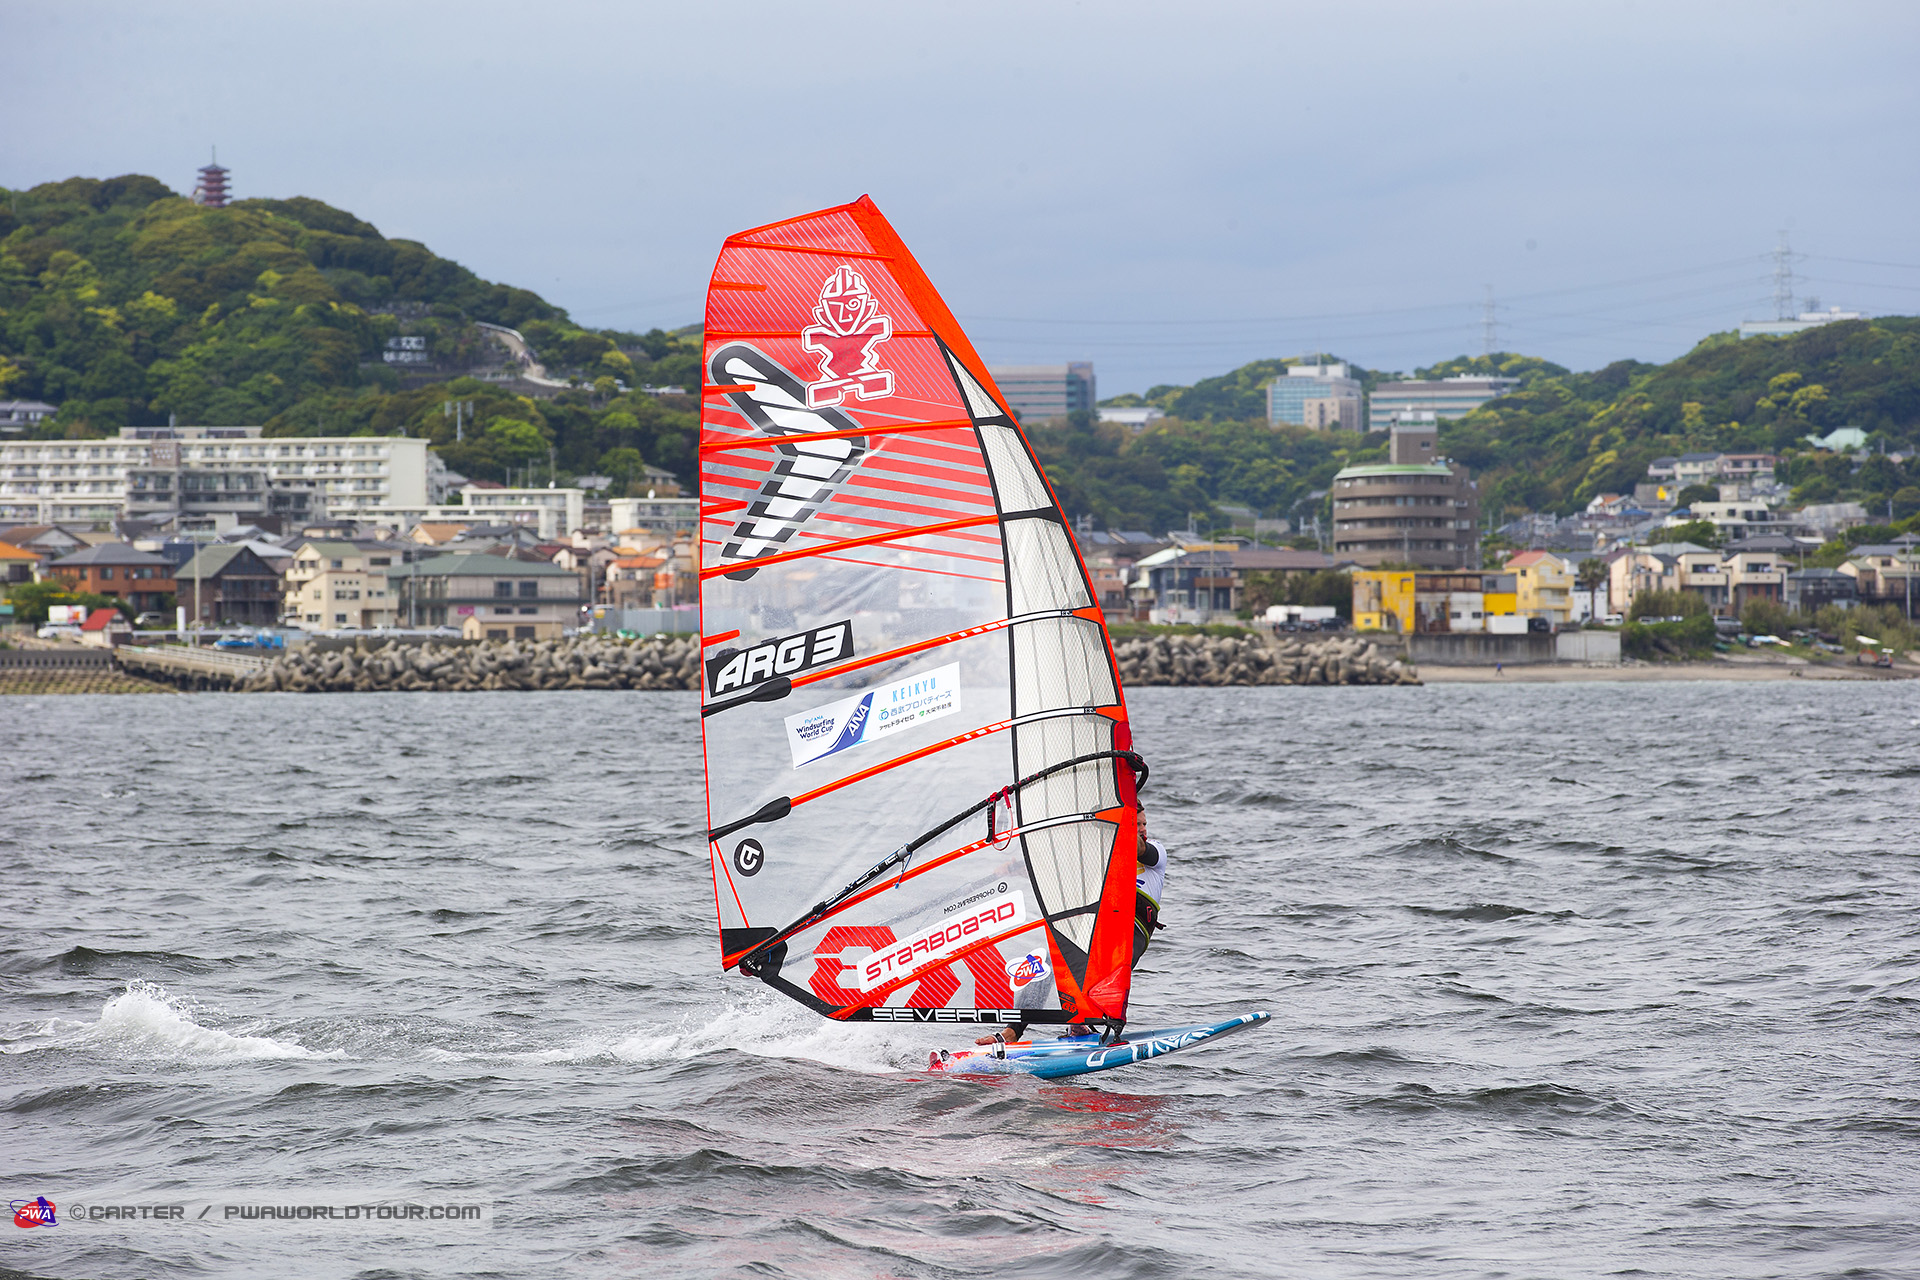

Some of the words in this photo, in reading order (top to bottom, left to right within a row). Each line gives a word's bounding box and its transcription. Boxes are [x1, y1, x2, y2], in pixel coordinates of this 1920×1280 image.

[714, 634, 808, 694] ARG
[810, 623, 847, 667] 3
[892, 677, 936, 703] KEIKYU
[795, 718, 835, 734] Windsurfing
[848, 704, 870, 737] ANA
[799, 730, 820, 740] World
[820, 725, 834, 735] Cup
[1016, 961, 1042, 980] PWA
[871, 1007, 1022, 1023] SEVERNE
